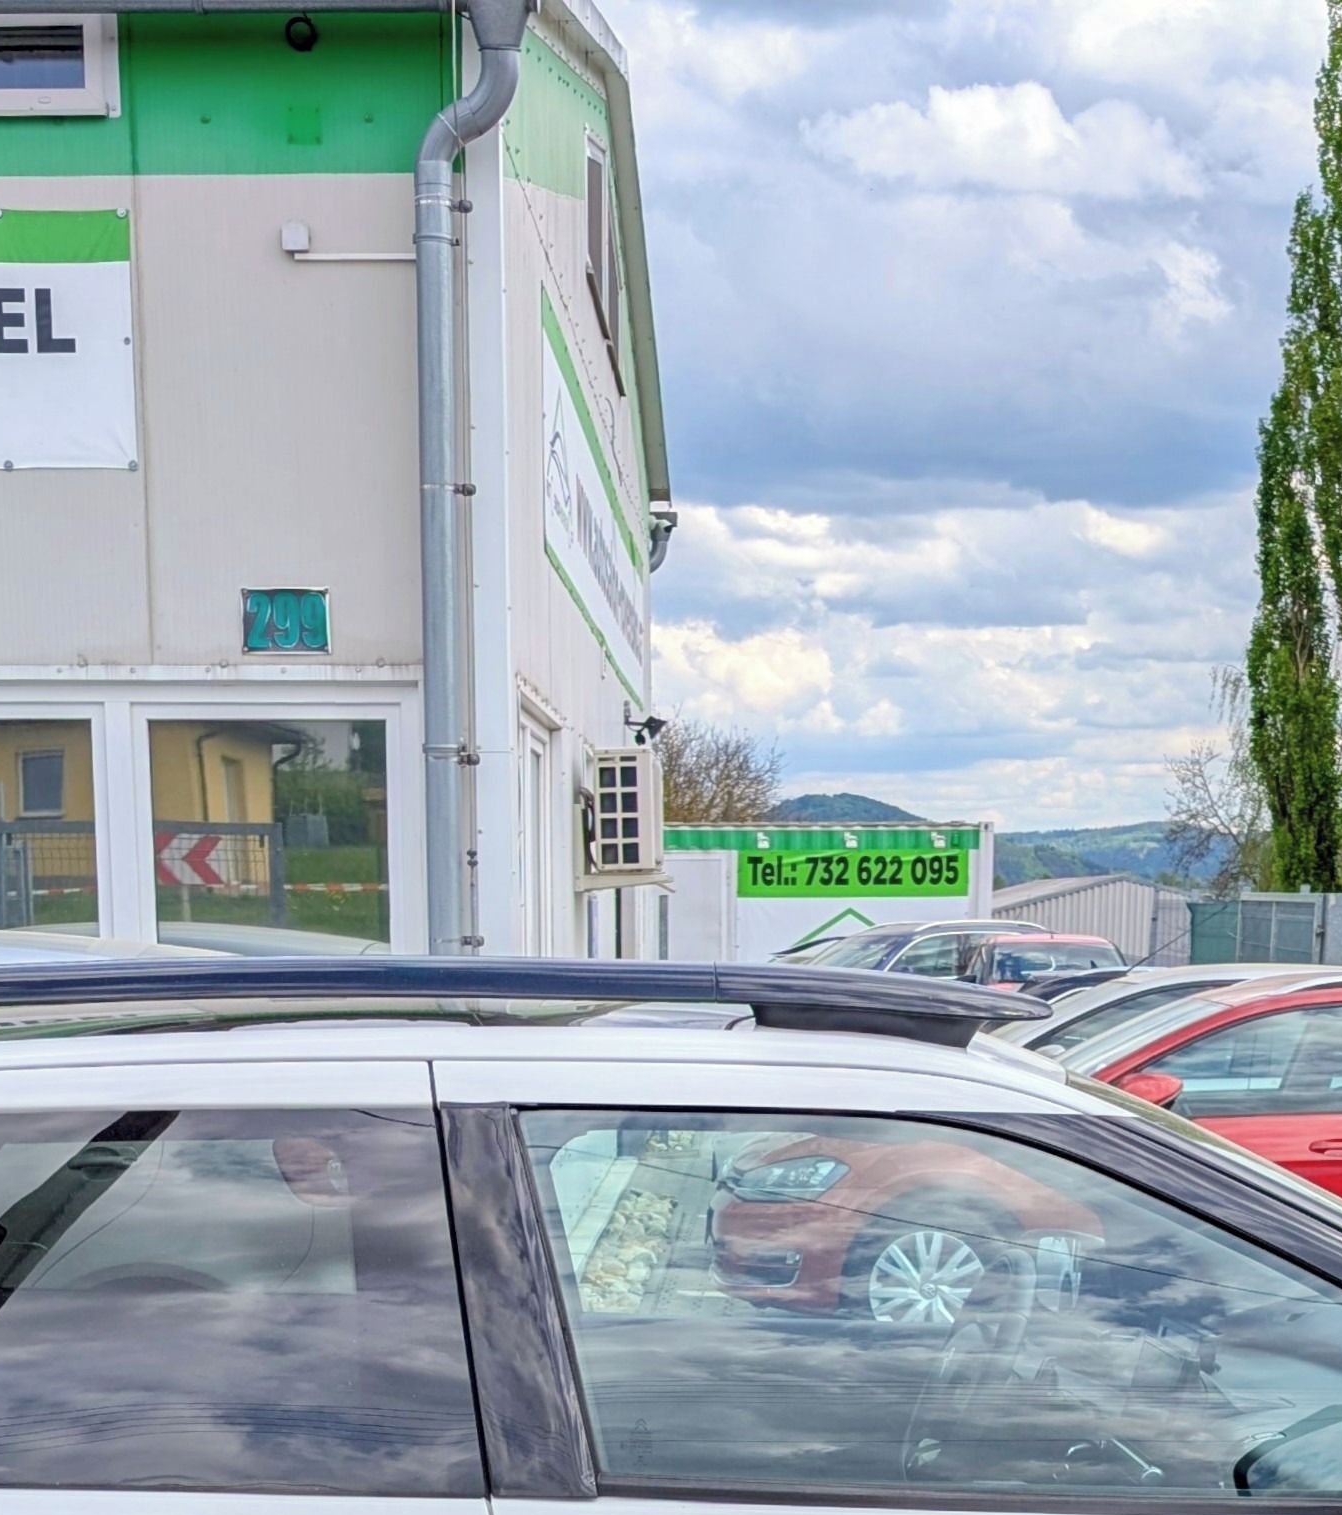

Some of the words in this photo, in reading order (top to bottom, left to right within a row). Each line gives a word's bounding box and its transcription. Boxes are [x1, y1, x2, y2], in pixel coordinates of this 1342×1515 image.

[247, 591, 326, 648] 299
[747, 856, 797, 886] Tel.:
[805, 856, 849, 886] 732
[857, 856, 902, 886] 622
[911, 855, 959, 886] 095
